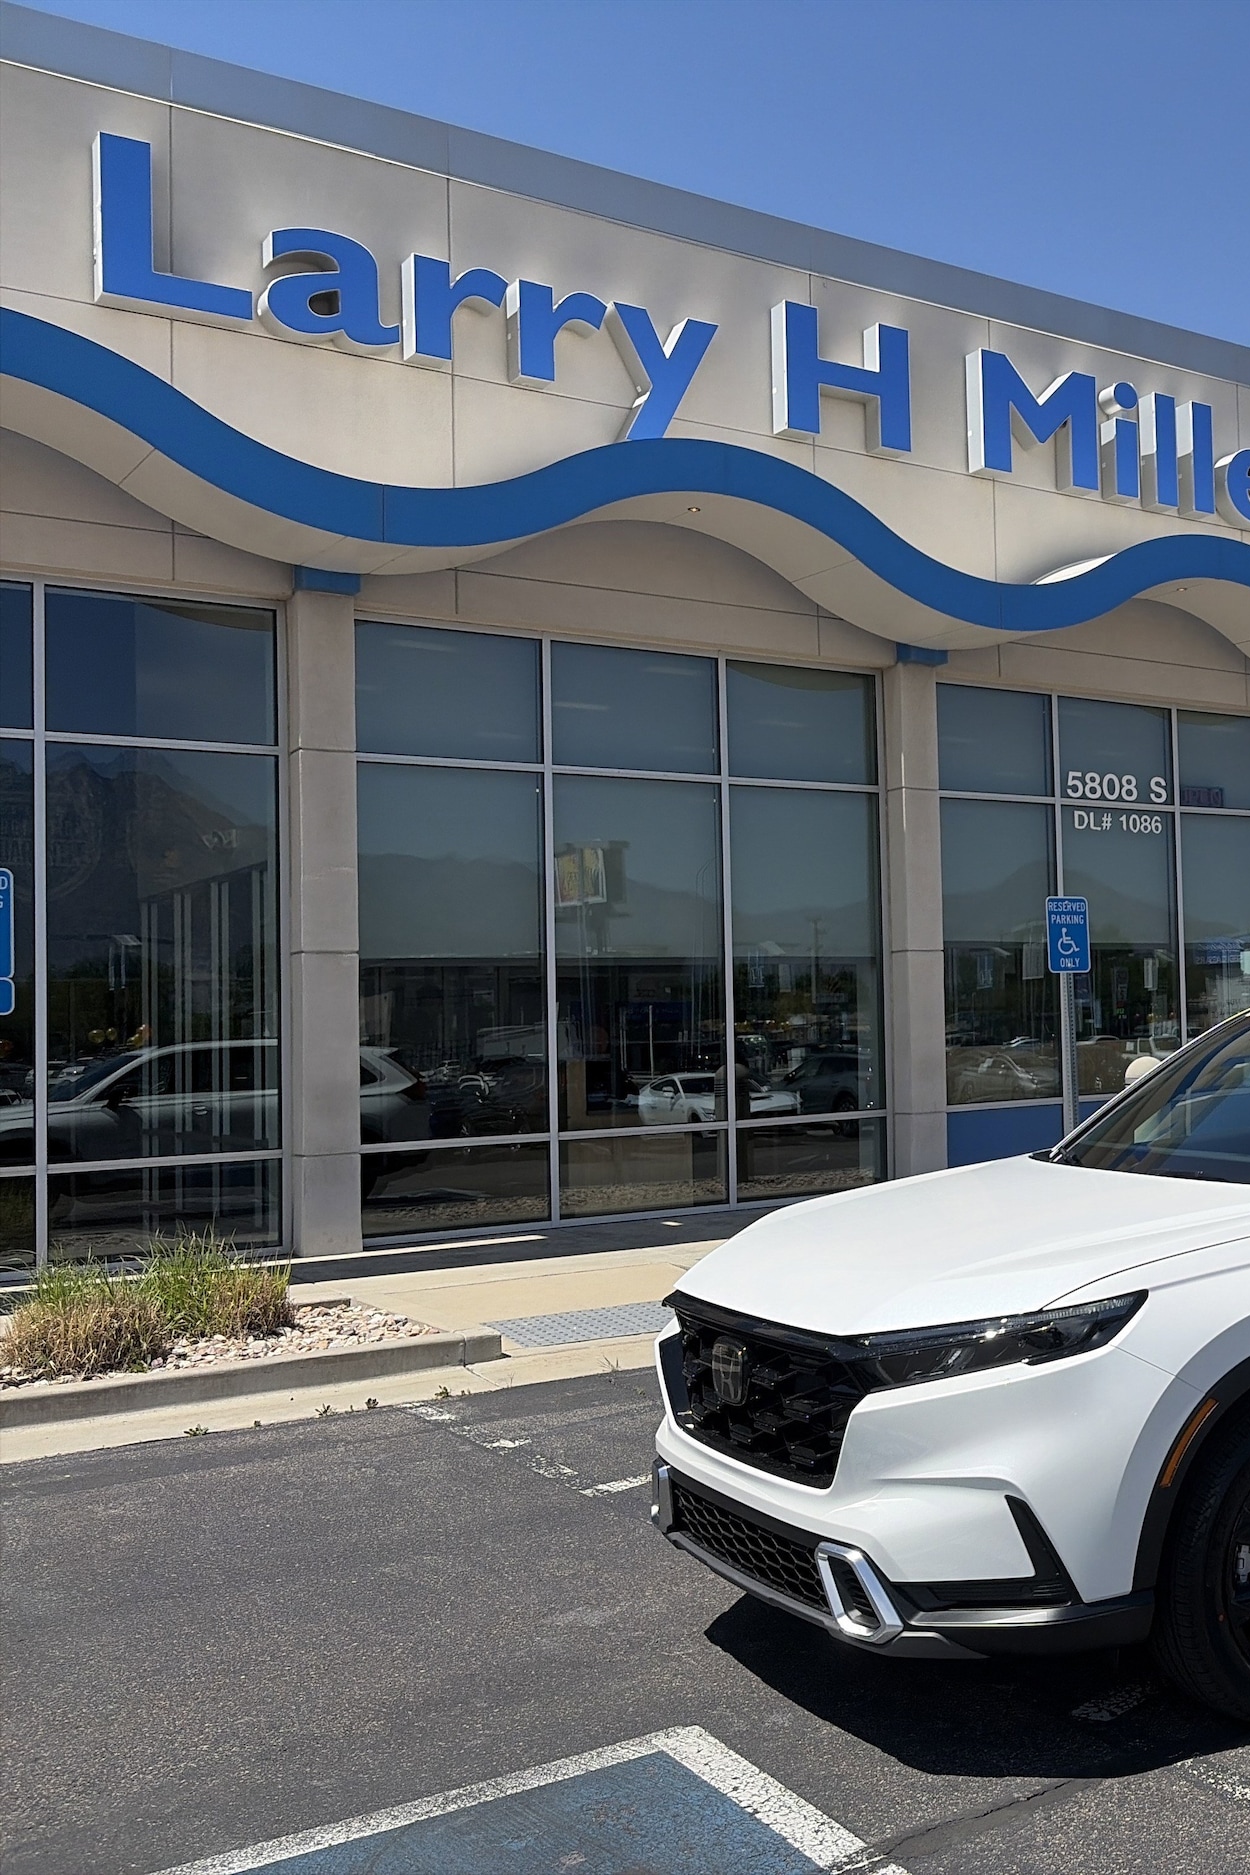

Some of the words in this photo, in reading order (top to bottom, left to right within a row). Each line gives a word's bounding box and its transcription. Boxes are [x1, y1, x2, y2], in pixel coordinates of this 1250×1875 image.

[93, 130, 719, 442] Larry
[771, 299, 912, 455] H
[1067, 771, 1138, 801] 5808
[1150, 777, 1167, 803] S
[1074, 811, 1112, 830] DL#
[1119, 814, 1162, 834] 1086
[1048, 902, 1086, 912] RESERVED
[1051, 915, 1084, 924] PARKING
[1060, 958, 1080, 968] ONLY
